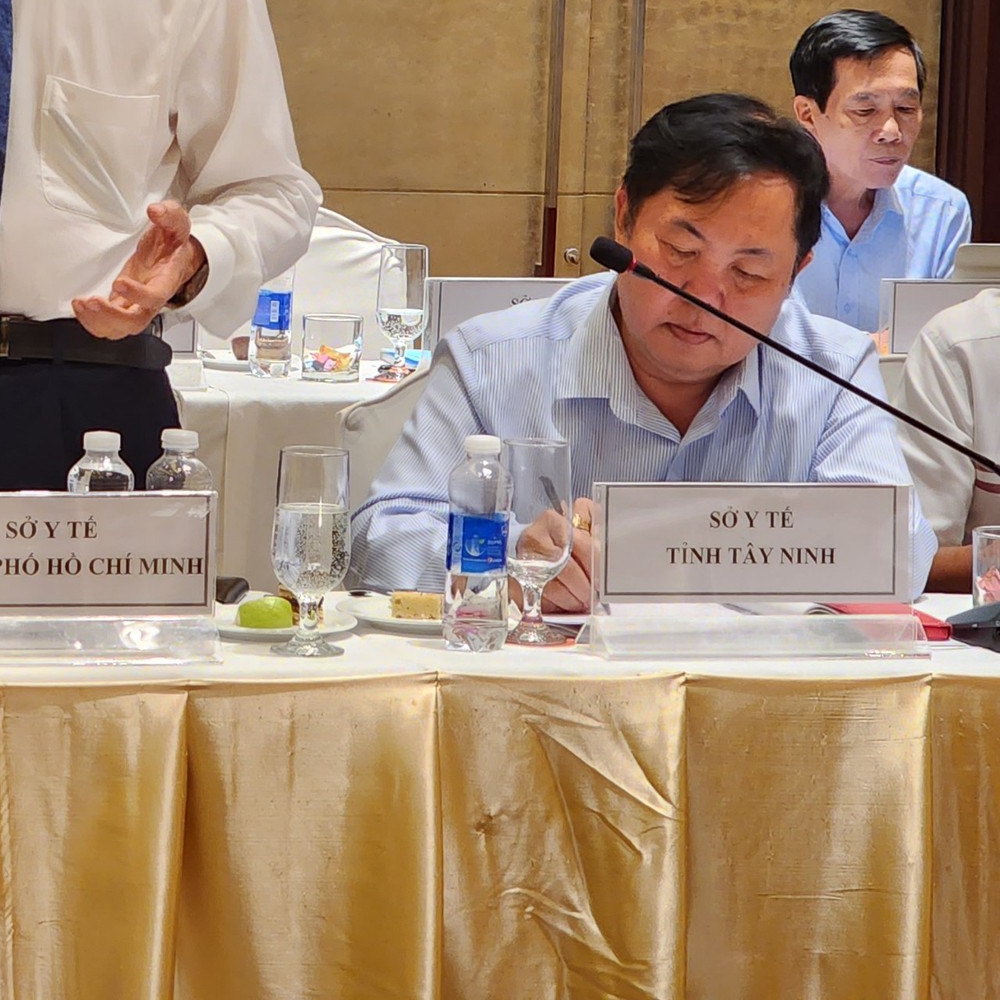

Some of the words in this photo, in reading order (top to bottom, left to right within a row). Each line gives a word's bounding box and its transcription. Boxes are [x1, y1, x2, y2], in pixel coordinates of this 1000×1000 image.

[5, 515, 38, 539] SỞ
[43, 521, 60, 538] Y
[67, 515, 98, 538] TẾ
[709, 506, 739, 528] SỞ
[744, 511, 759, 528] Y
[765, 506, 794, 528] TẾ
[46, 552, 82, 576] HỒ
[89, 552, 133, 576] CHÍ
[138, 557, 204, 575] MINH
[666, 541, 721, 564] TỈNH
[728, 542, 774, 564] TÂY
[780, 547, 836, 564] NINH
